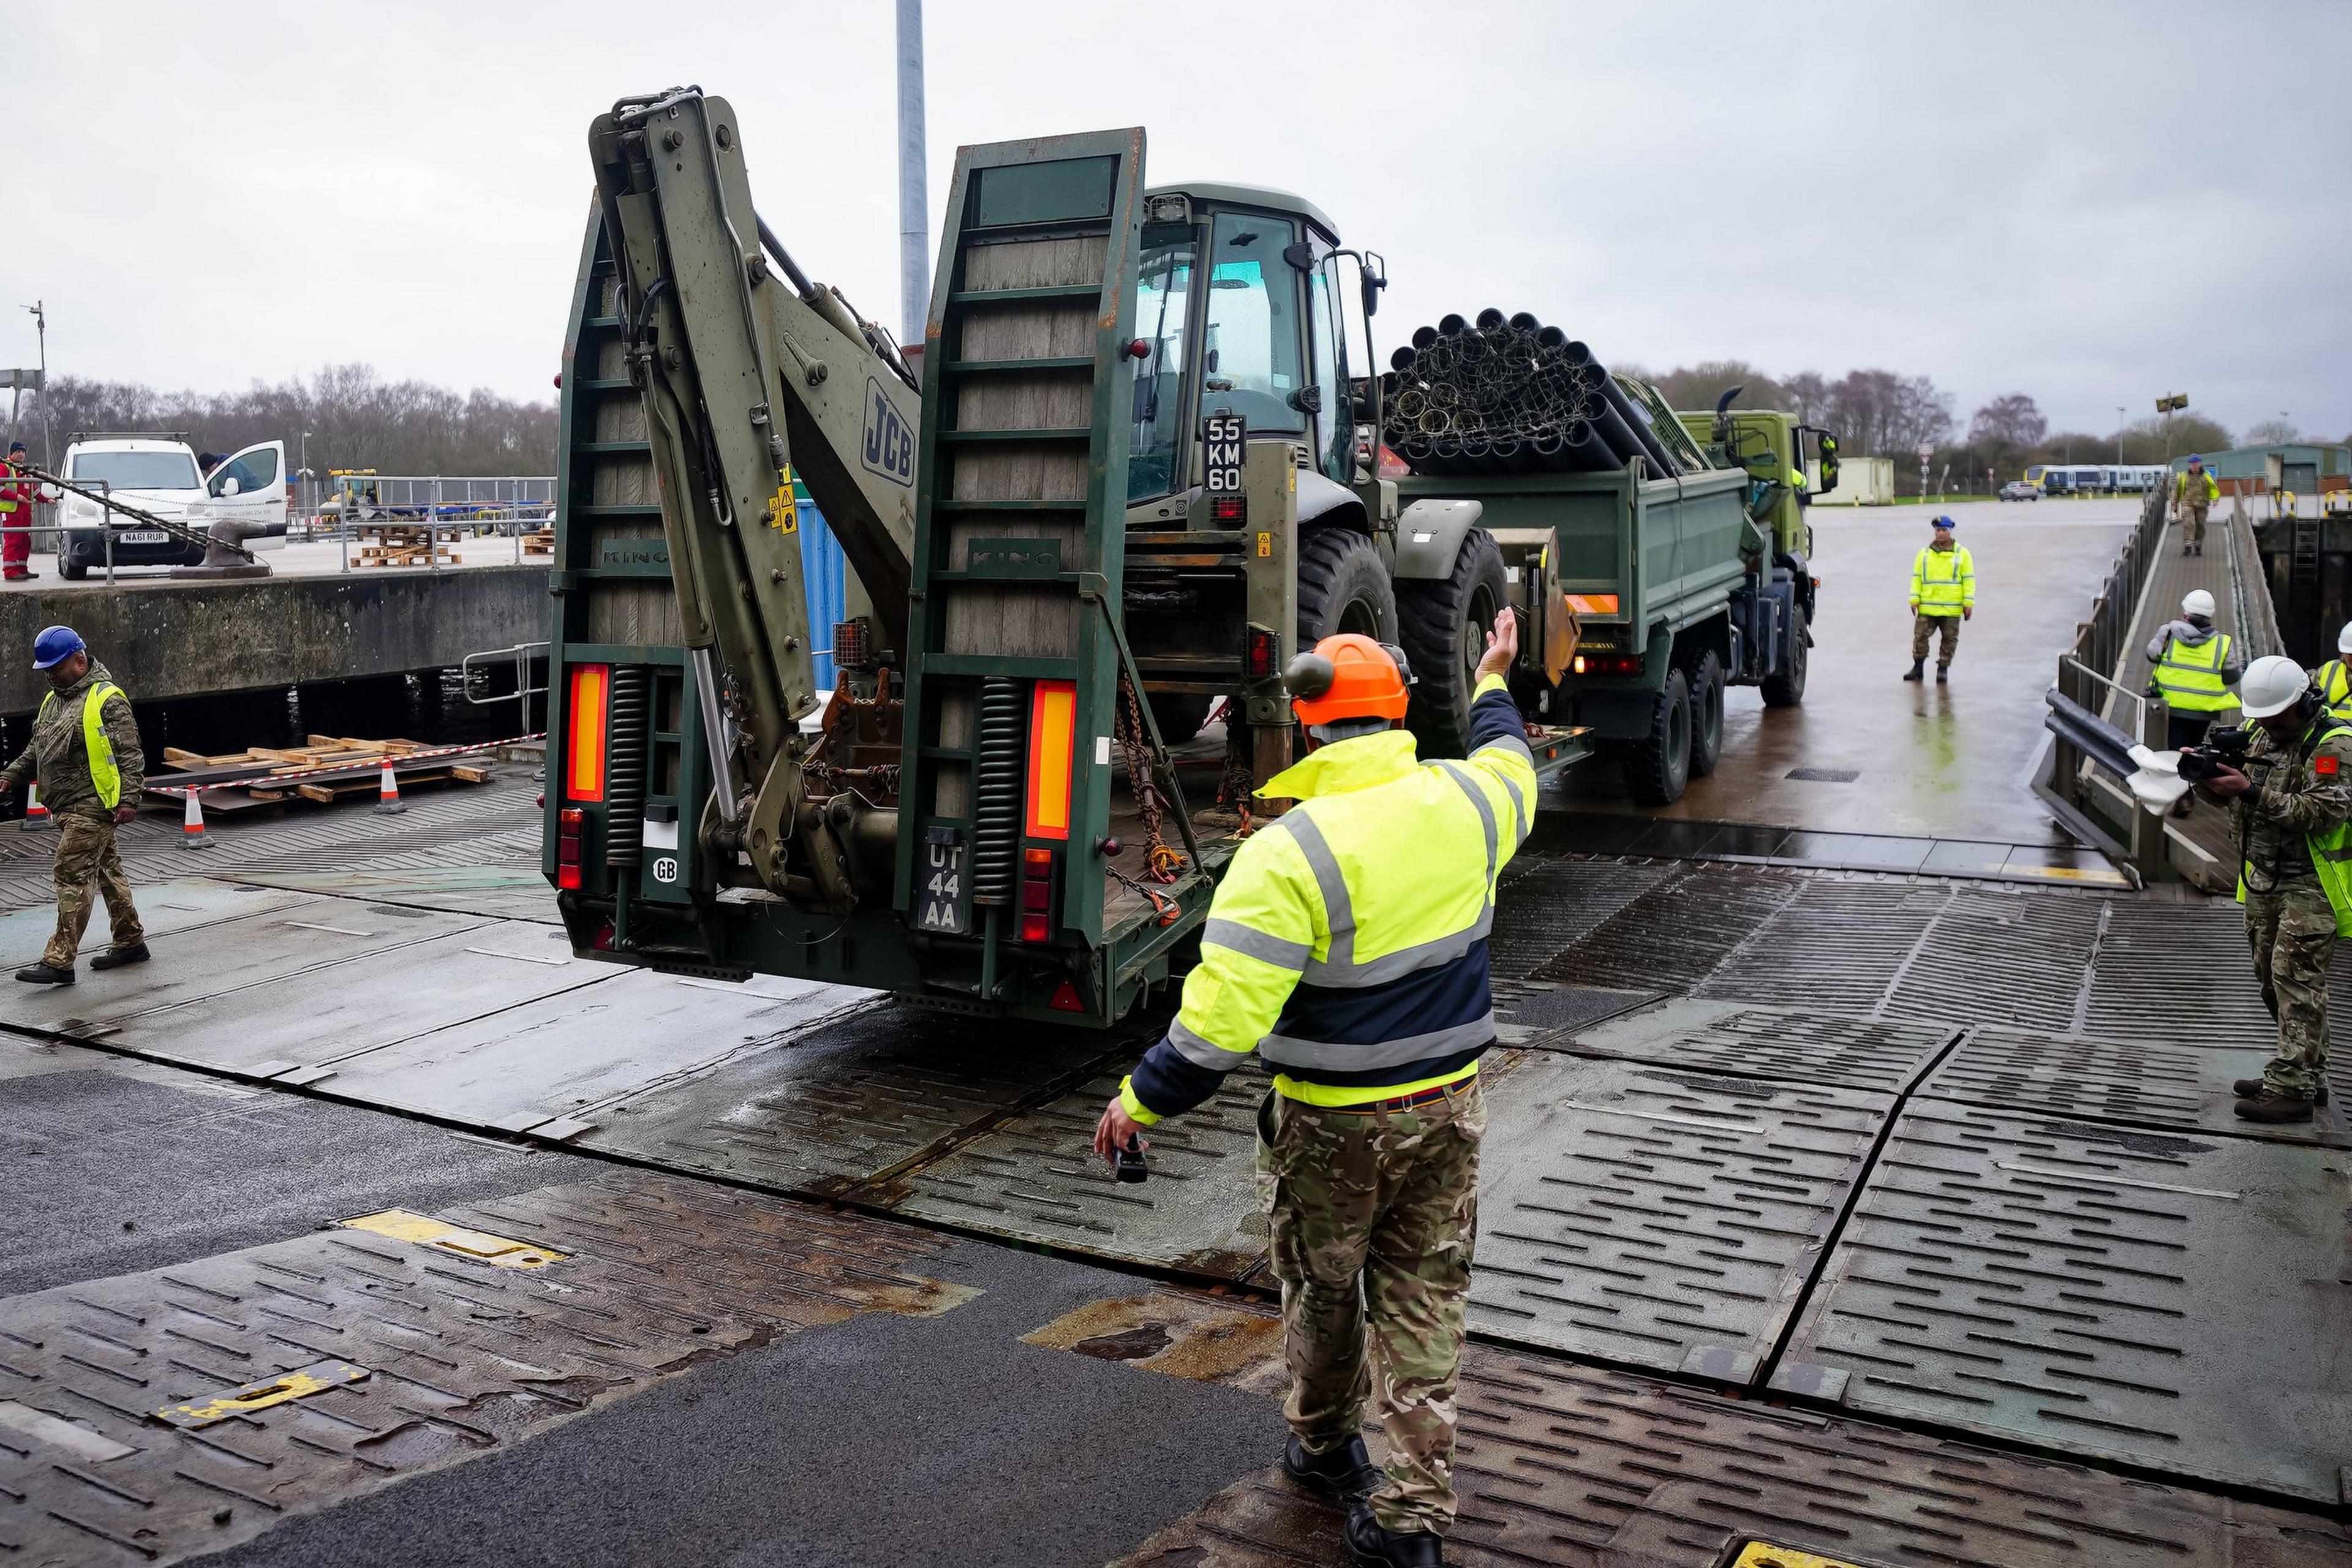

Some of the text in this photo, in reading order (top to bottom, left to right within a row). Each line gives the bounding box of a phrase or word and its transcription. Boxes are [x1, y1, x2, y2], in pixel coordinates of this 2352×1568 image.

[866, 392, 912, 478] JCB
[1209, 418, 1240, 441] 55
[1208, 443, 1240, 466] KM
[1208, 469, 1240, 491] 60
[604, 551, 669, 564] KING
[973, 552, 1057, 566] KING
[930, 845, 962, 870] UT
[657, 861, 676, 879] GB
[928, 872, 959, 899] 44
[924, 901, 956, 927] AA
